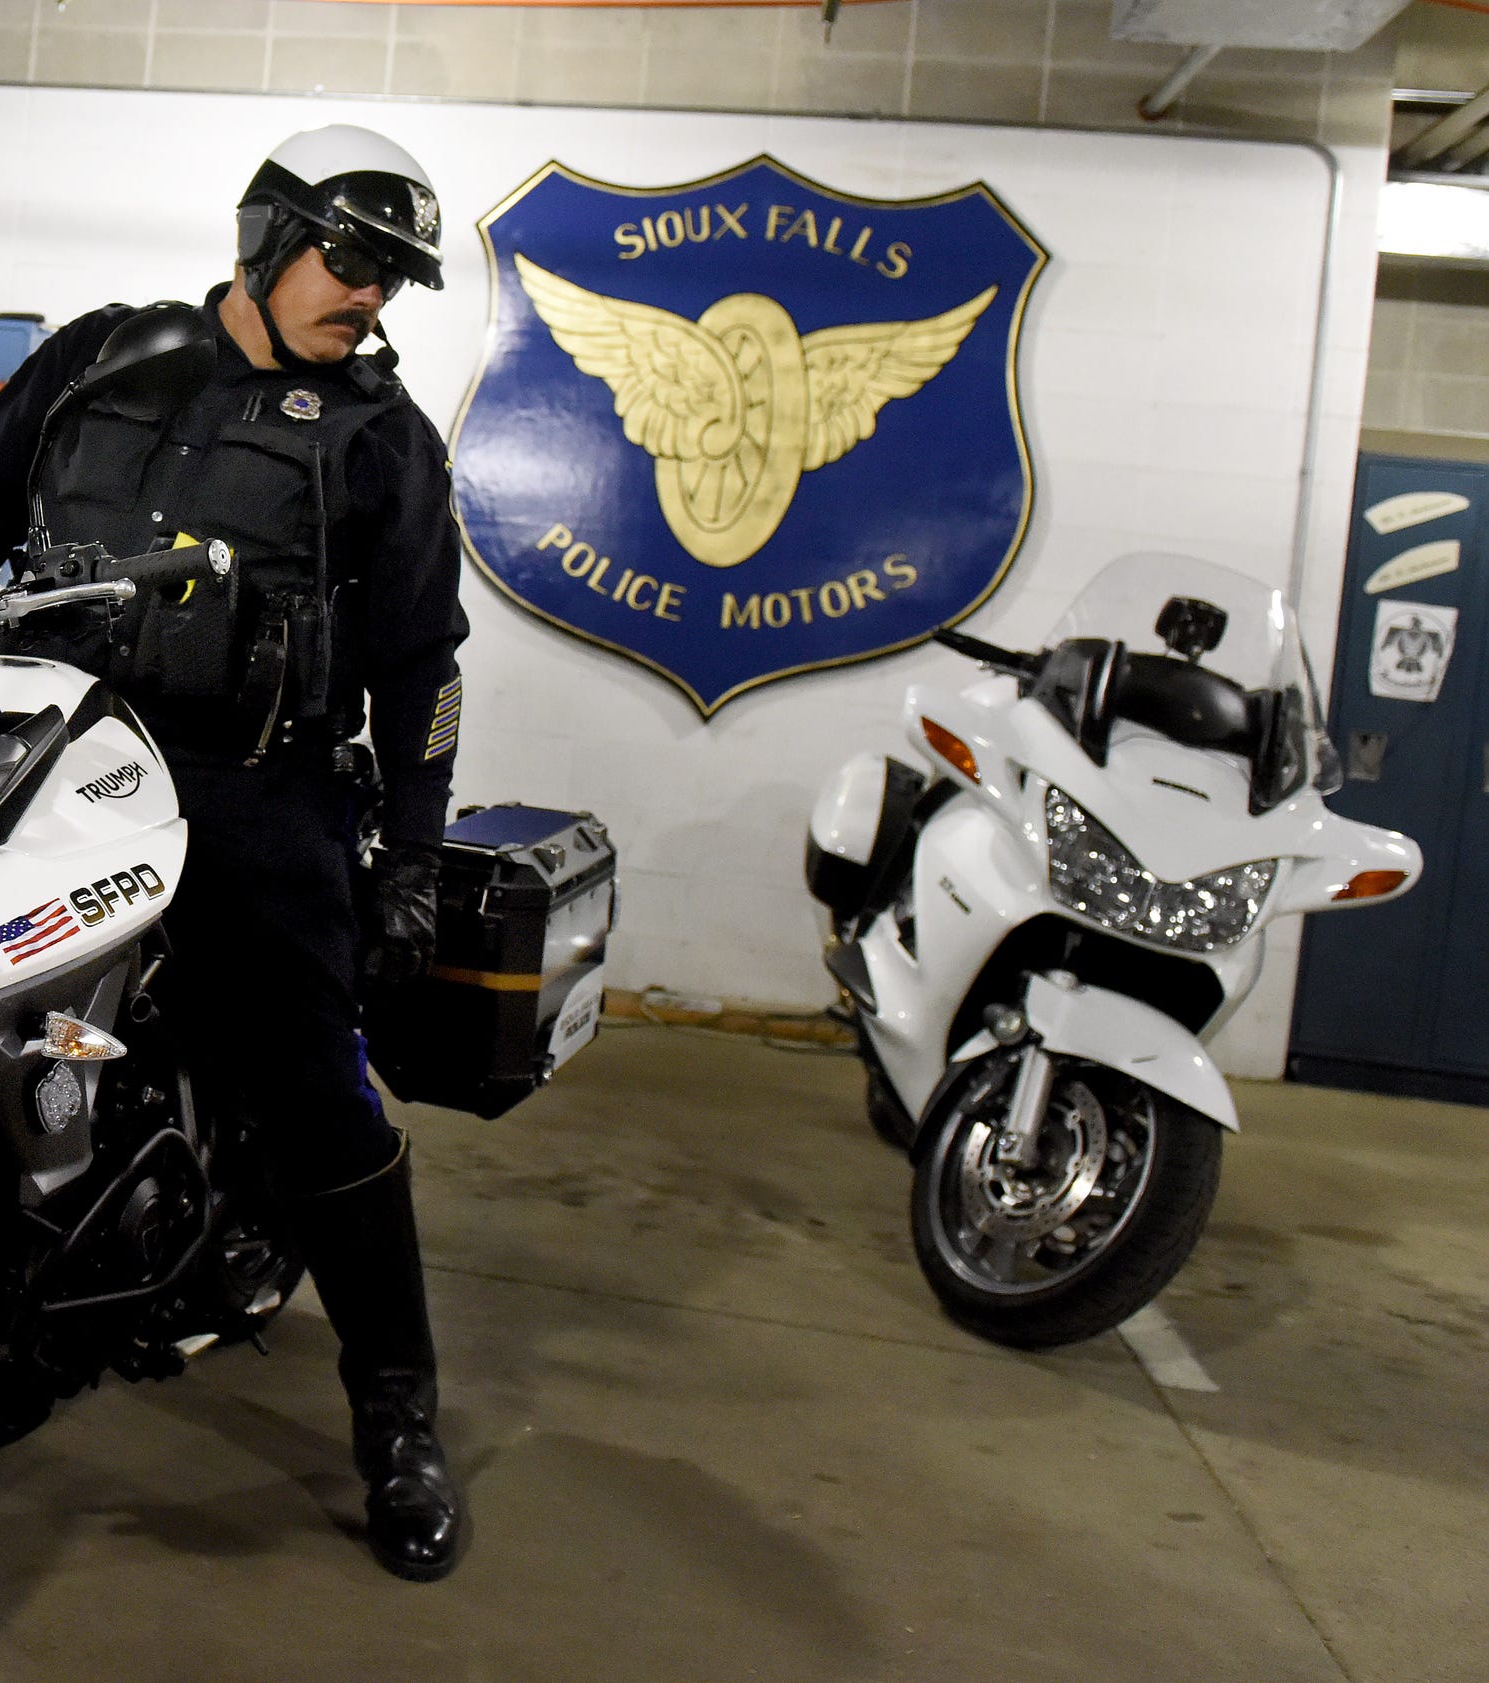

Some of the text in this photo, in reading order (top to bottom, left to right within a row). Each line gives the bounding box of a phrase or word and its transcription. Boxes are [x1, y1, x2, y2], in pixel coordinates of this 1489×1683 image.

[613, 203, 913, 280] SIOUX FALLS
[535, 522, 919, 631] POLICE MOTORS
[75, 761, 148, 803] TRIUMPH
[69, 863, 166, 928] SFPD
